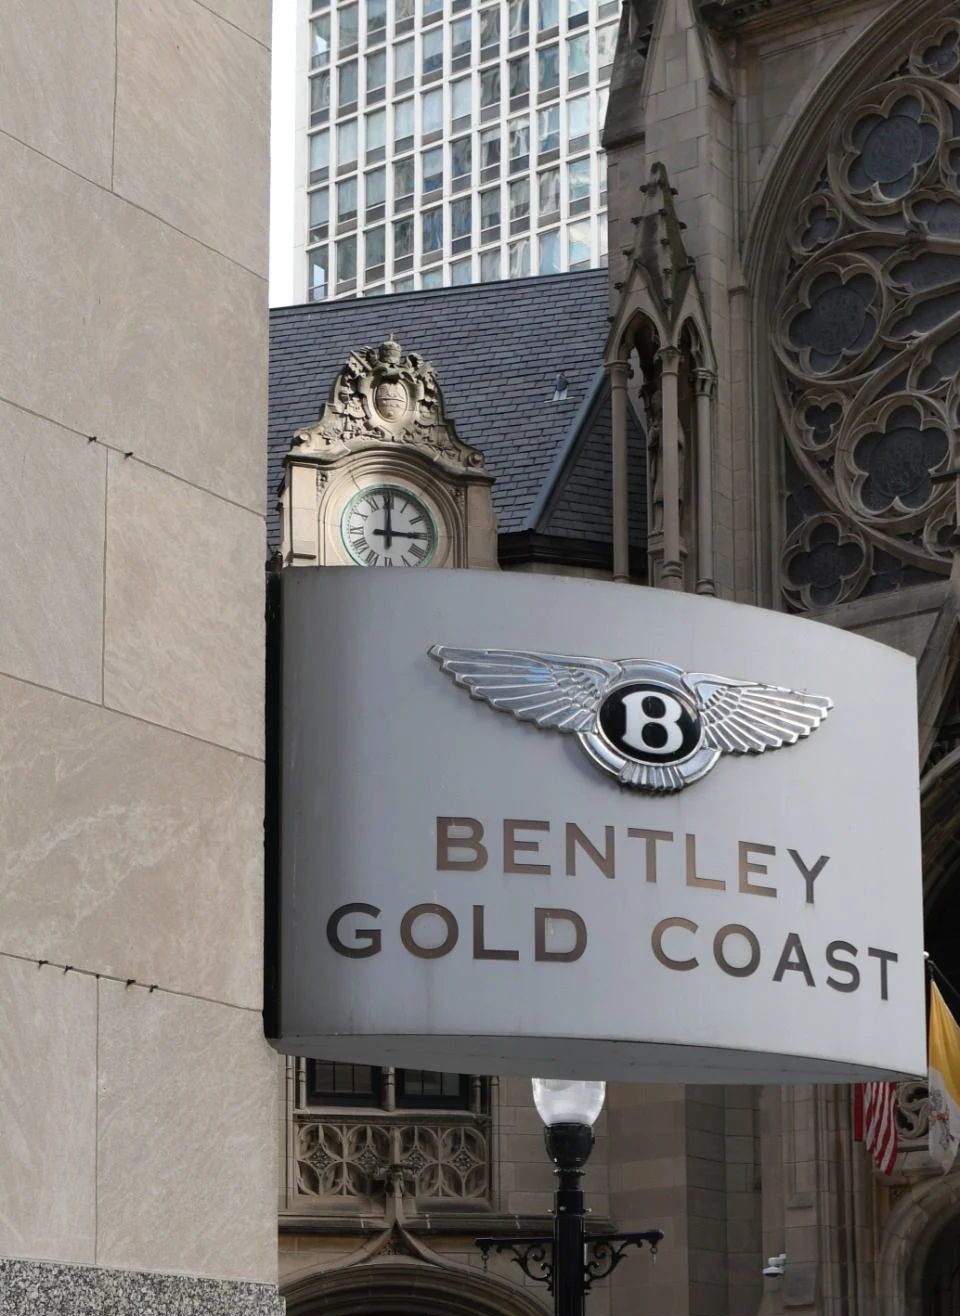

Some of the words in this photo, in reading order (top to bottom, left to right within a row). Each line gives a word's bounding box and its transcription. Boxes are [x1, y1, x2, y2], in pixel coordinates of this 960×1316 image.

[621, 690, 684, 755] B
[435, 815, 830, 904] BENTLEY
[326, 901, 588, 963] GOLD
[651, 916, 899, 1000] COAST
